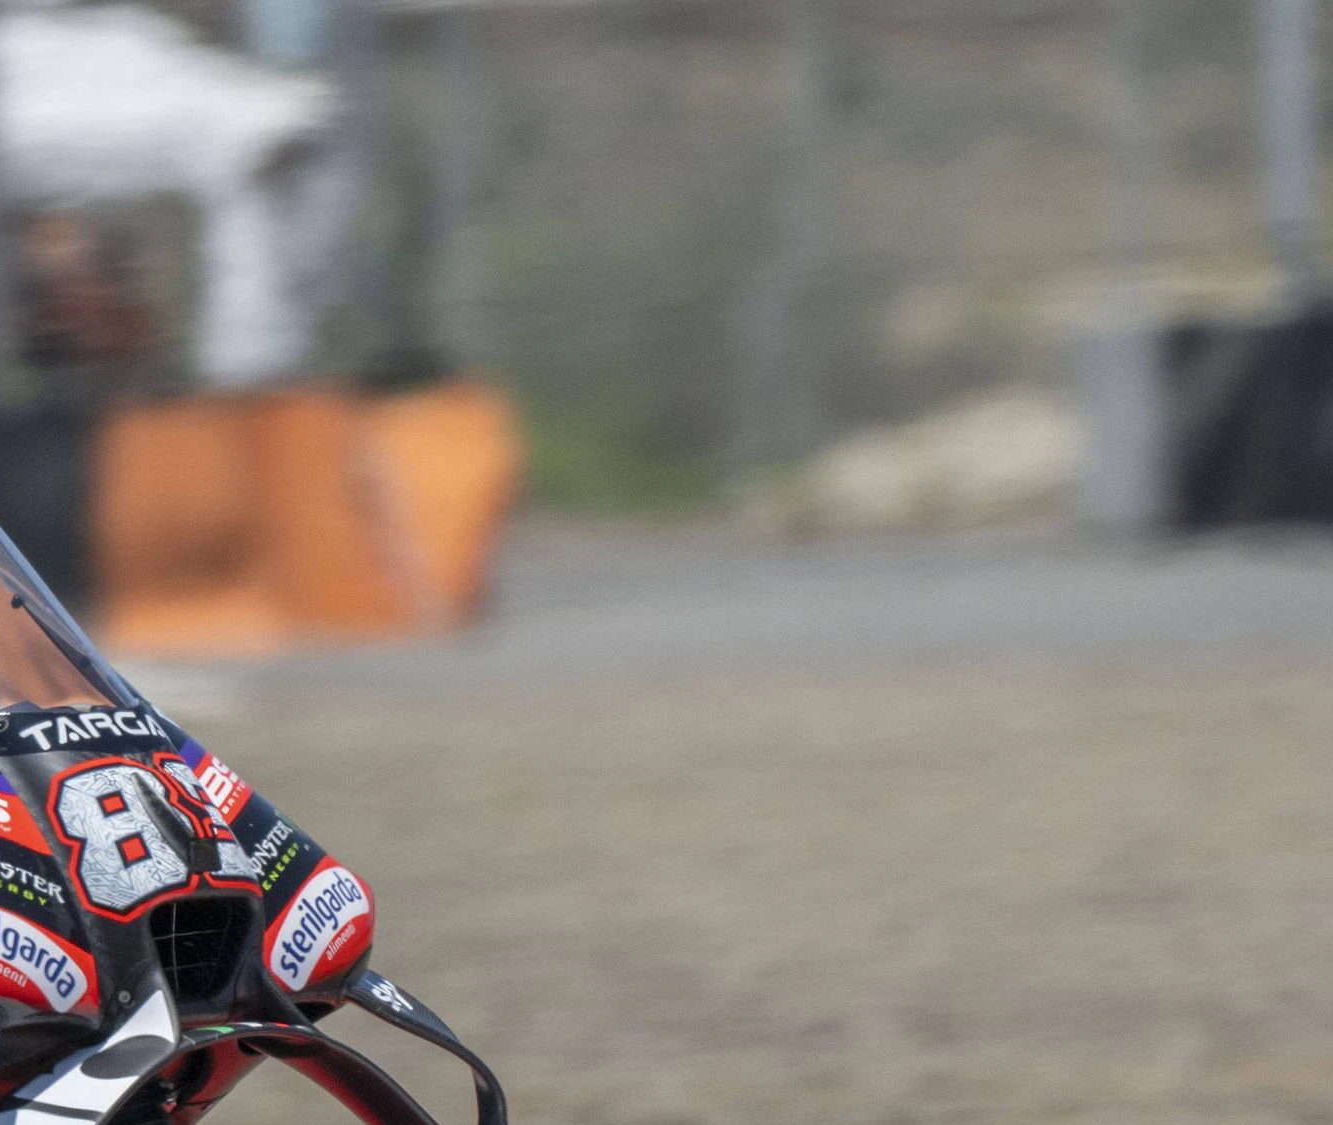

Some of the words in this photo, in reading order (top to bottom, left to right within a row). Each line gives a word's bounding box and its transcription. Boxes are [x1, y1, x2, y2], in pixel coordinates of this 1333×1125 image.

[19, 711, 168, 751] TARGA
[249, 820, 293, 876] ONSTER
[280, 871, 363, 979] sterilgarda
[326, 922, 357, 961] alimenti
